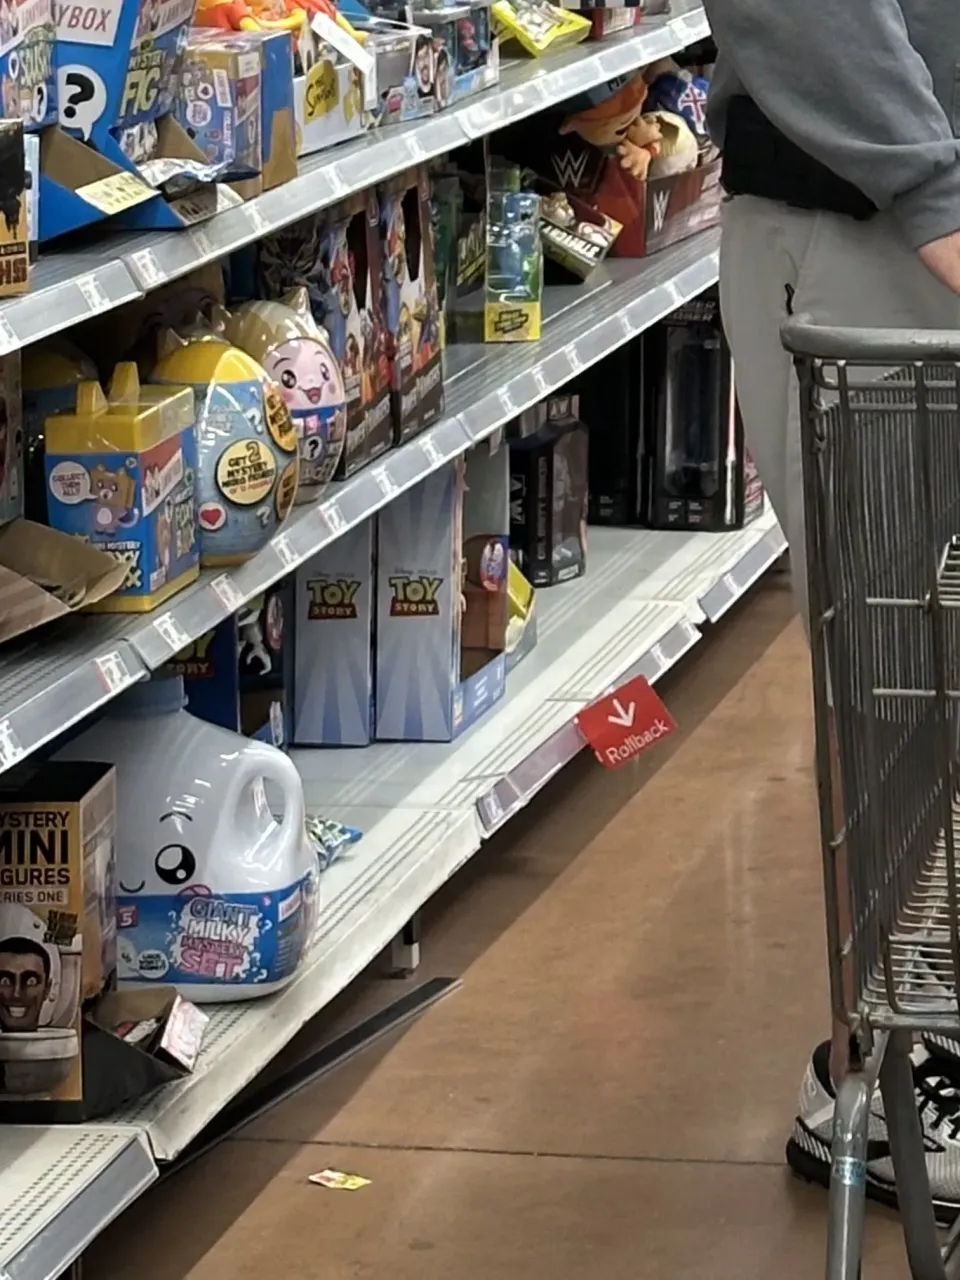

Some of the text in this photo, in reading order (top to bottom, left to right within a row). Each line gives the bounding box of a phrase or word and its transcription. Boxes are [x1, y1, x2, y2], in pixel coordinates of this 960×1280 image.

[227, 462, 268, 478] MYSTERY
[228, 456, 247, 468] GET
[306, 578, 362, 605] TOY
[388, 575, 444, 603] TOY
[312, 606, 353, 616] STORY
[394, 603, 435, 613] STORY
[605, 719, 669, 764] Rollback
[37, 891, 64, 902] ONE
[119, 911, 133, 927] 5
[190, 896, 258, 926] GIANT
[187, 917, 250, 942] MILKY
[177, 948, 246, 980] SET
